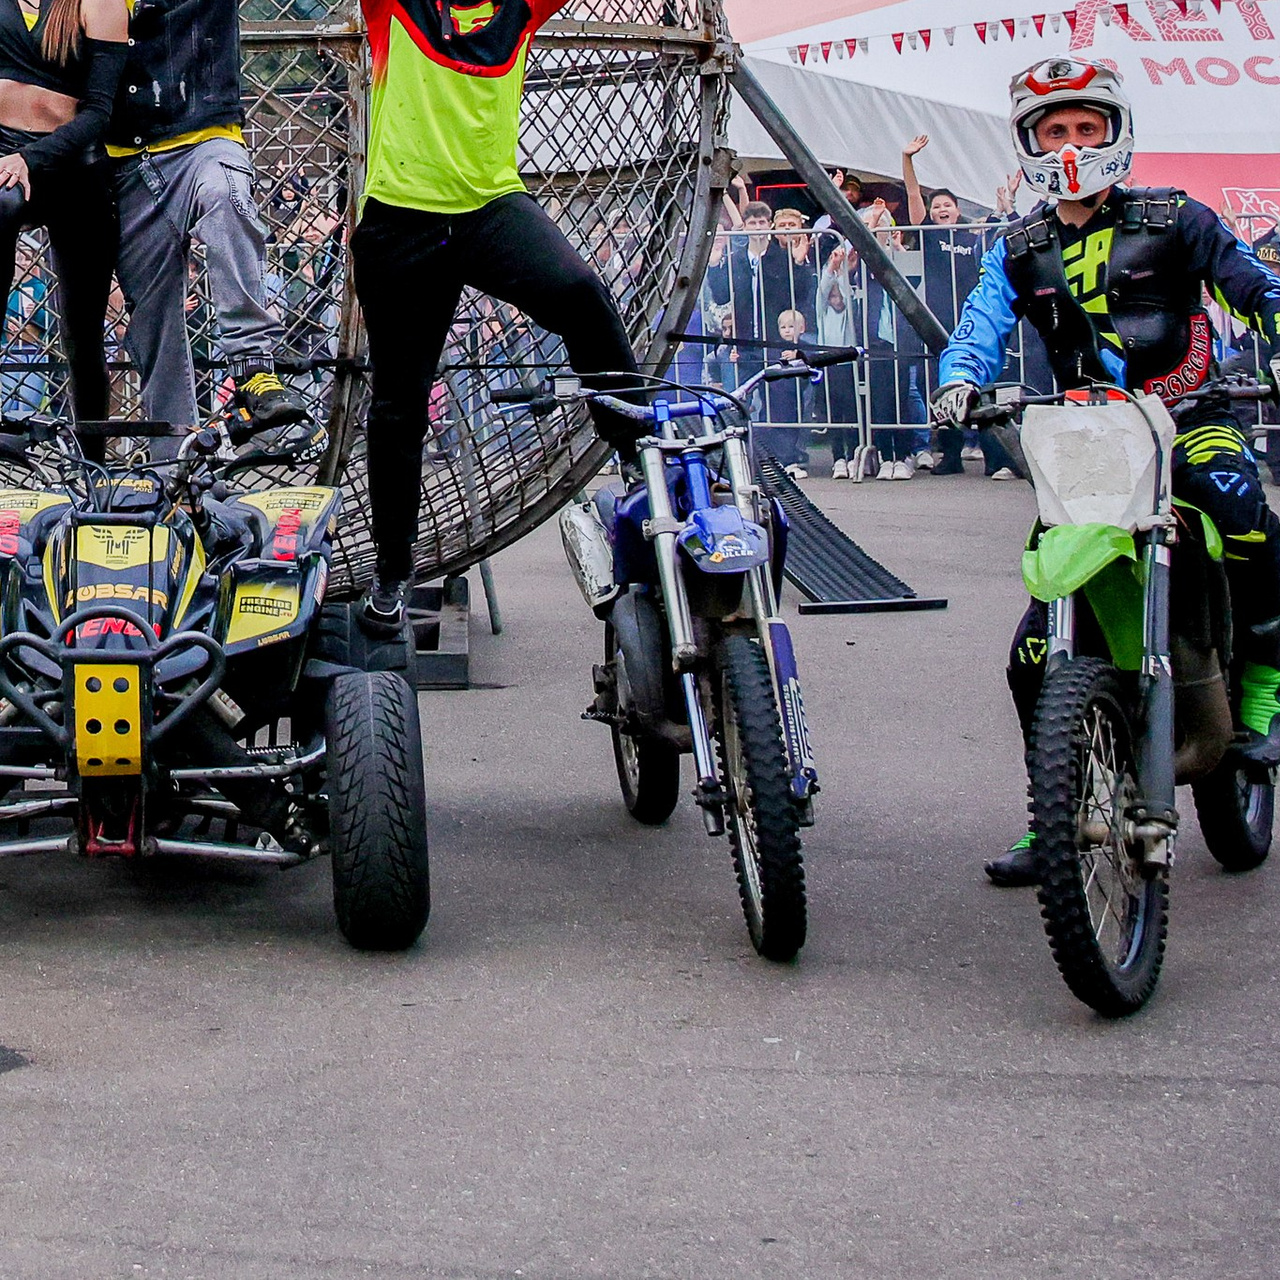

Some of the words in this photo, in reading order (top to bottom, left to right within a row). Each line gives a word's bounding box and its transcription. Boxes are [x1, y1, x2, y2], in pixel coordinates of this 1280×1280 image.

[1141, 55, 1280, 87] МОС
[1150, 319, 1208, 399] РОССИЯ
[133, 486, 153, 494] MOTO
[272, 507, 303, 561] KENDA
[65, 583, 169, 612] LUBSAR
[241, 598, 292, 610] FREERIDE
[782, 684, 801, 765] SUPERCROSS
